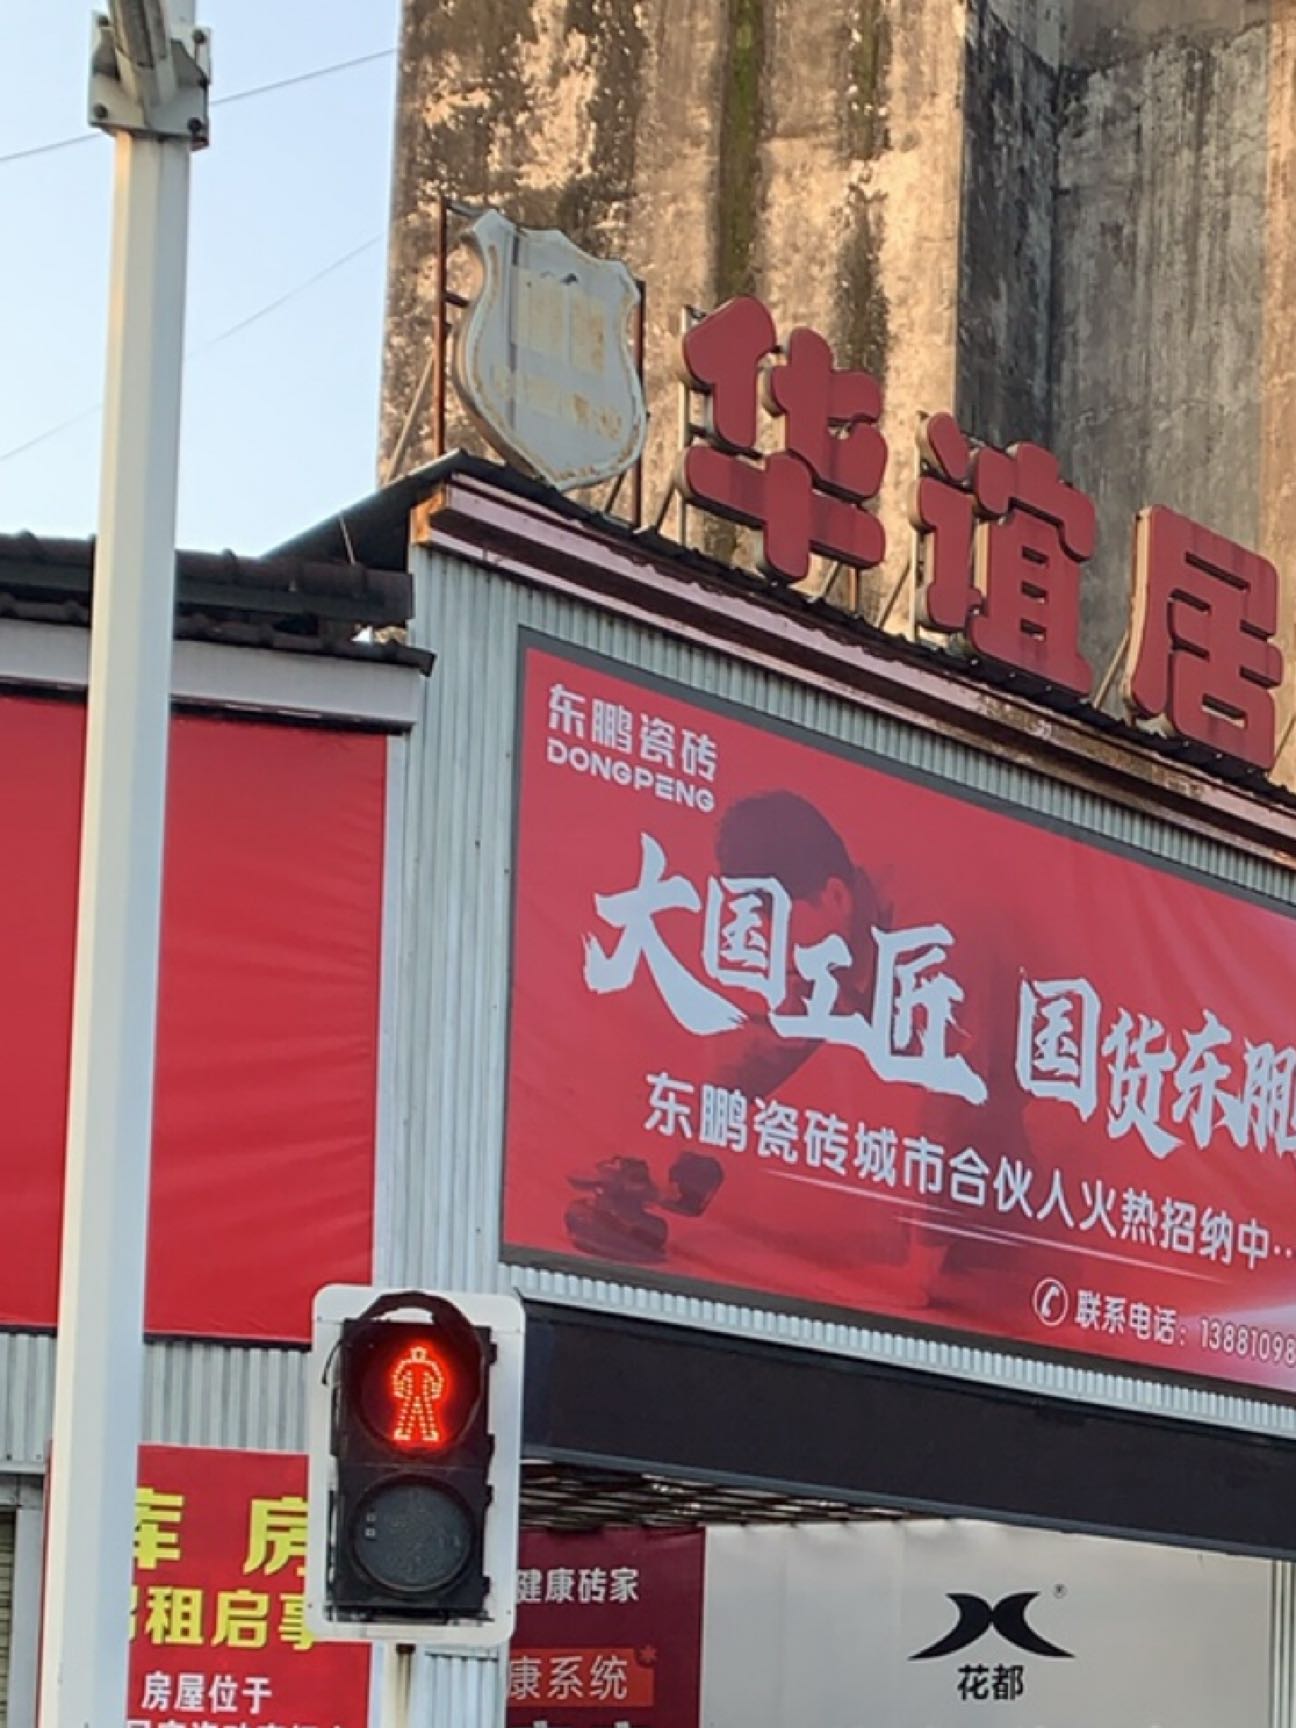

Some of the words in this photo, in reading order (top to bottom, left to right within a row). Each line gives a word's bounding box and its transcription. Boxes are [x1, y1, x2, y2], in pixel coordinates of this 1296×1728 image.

[548, 683, 718, 782] 东鹏瓷砖
[547, 739, 715, 812] DONGPENG
[582, 832, 987, 1104] 大国工匠
[517, 1567, 640, 1604] 健康砖家
[129, 1585, 314, 1650] 租启事
[141, 1671, 273, 1714] 房屋位于
[510, 1655, 628, 1700] 康系统
[957, 1664, 1025, 1700] 花都
